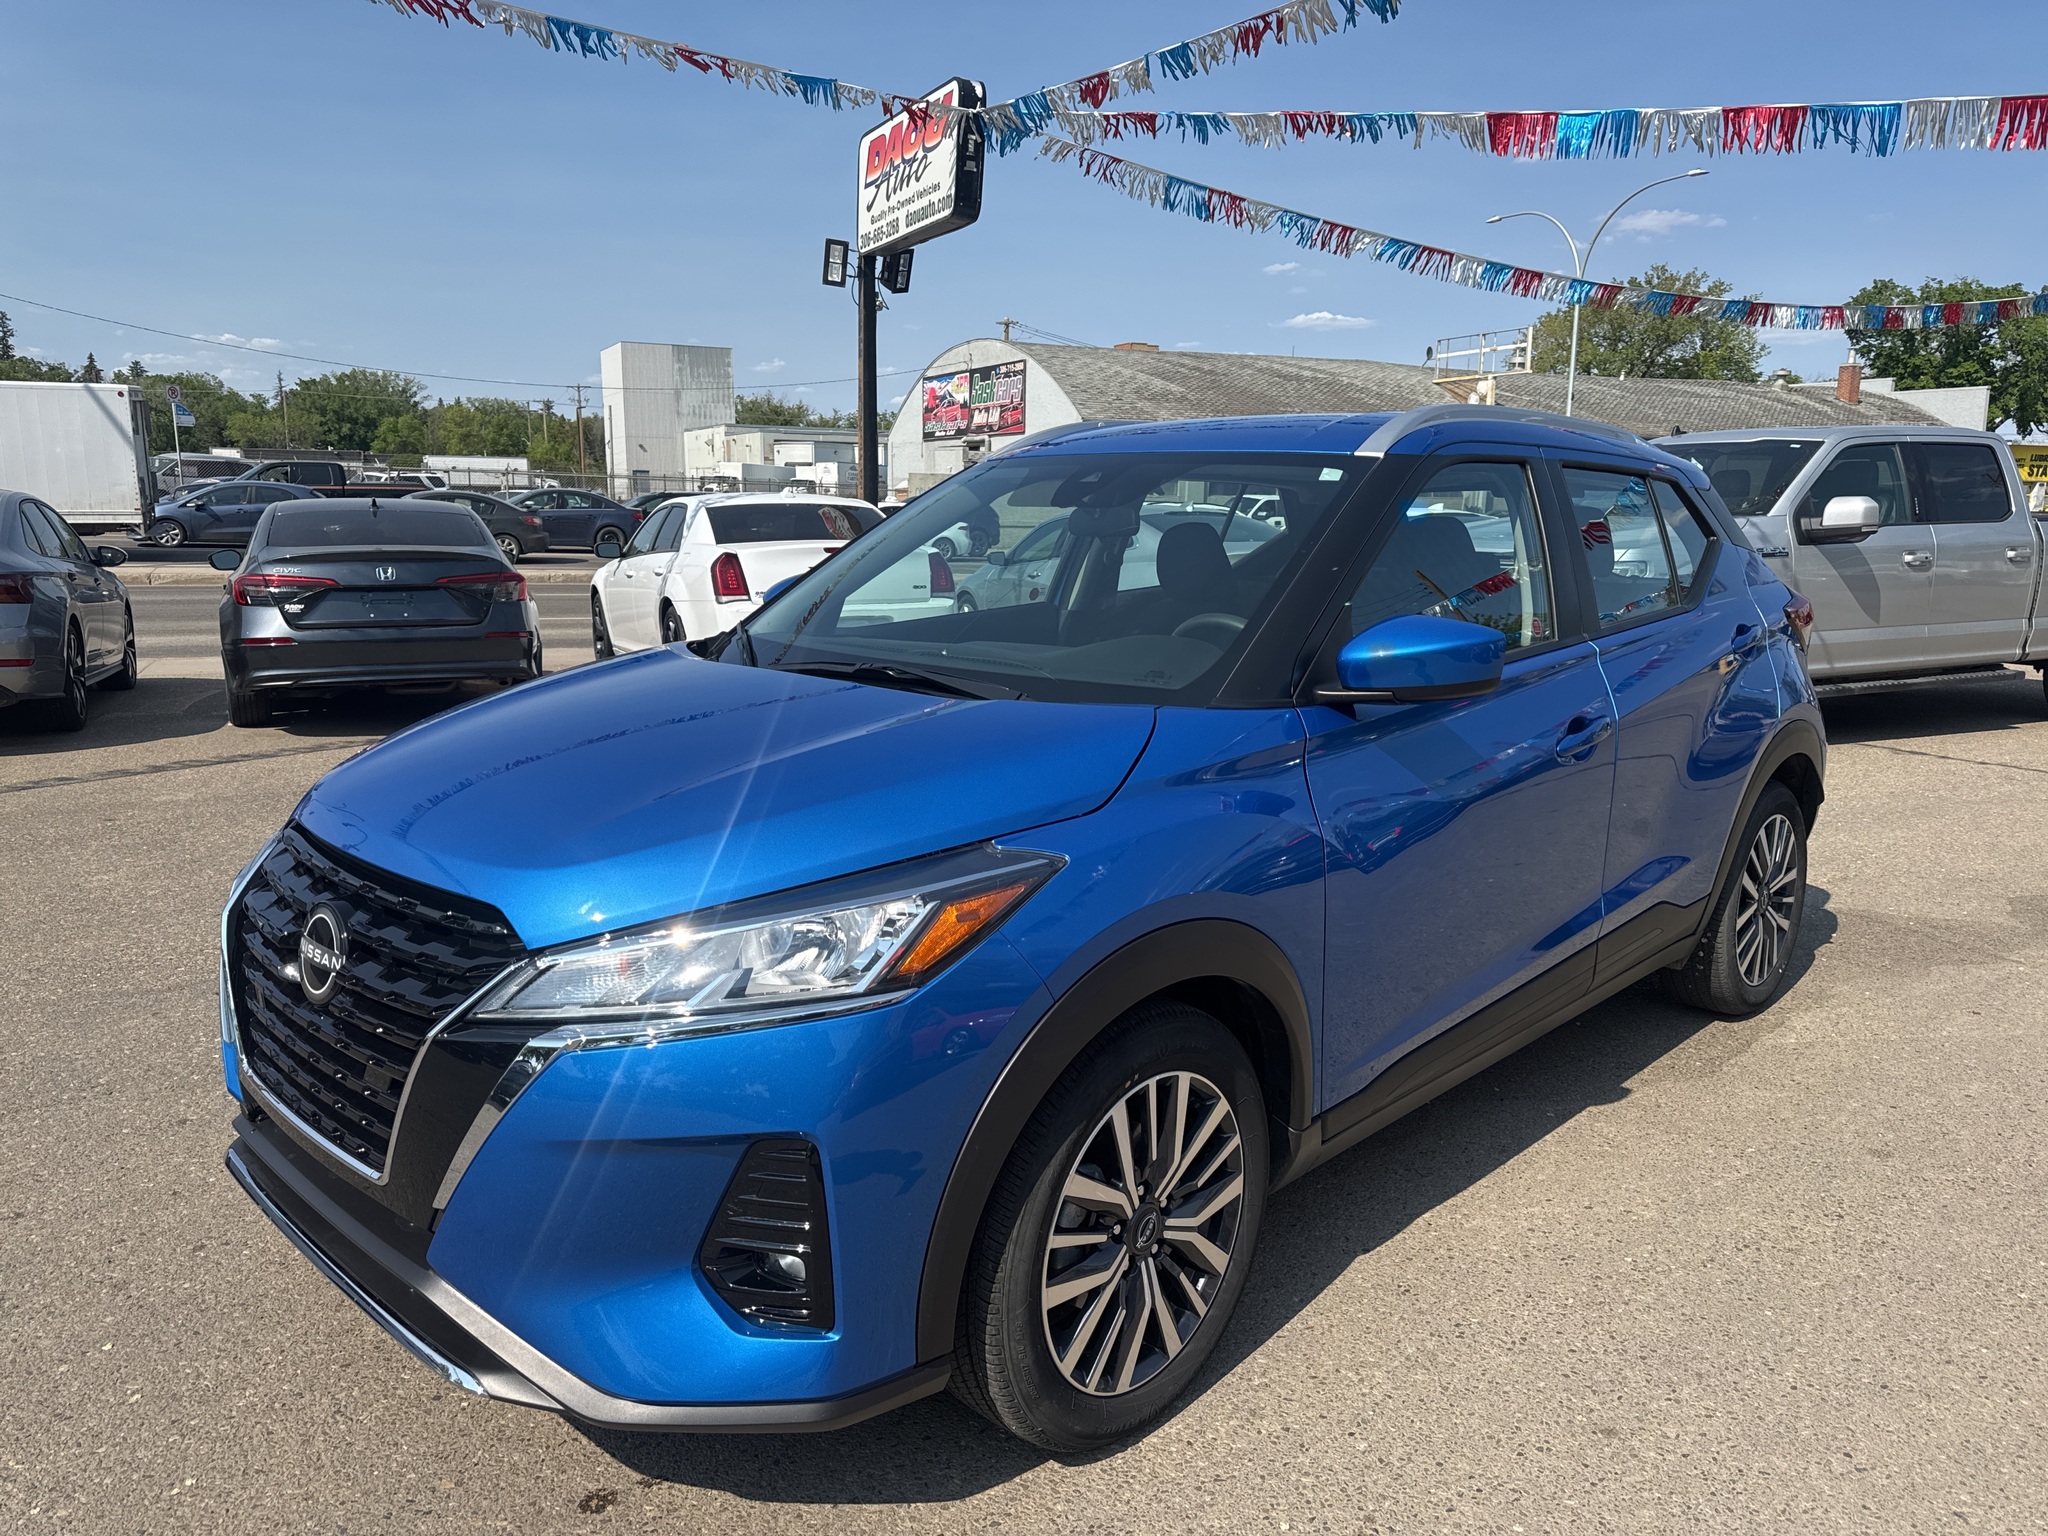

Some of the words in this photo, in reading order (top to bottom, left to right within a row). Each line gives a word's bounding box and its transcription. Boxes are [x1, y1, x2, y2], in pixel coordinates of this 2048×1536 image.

[866, 152, 932, 212] Auto
[871, 207, 887, 226] Quality
[888, 196, 915, 216] Pre-Owned
[916, 181, 941, 200] Vehicles
[860, 217, 899, 250] 306-665-3268
[905, 192, 953, 229] daouauto.com
[300, 937, 341, 970] NISSAN
